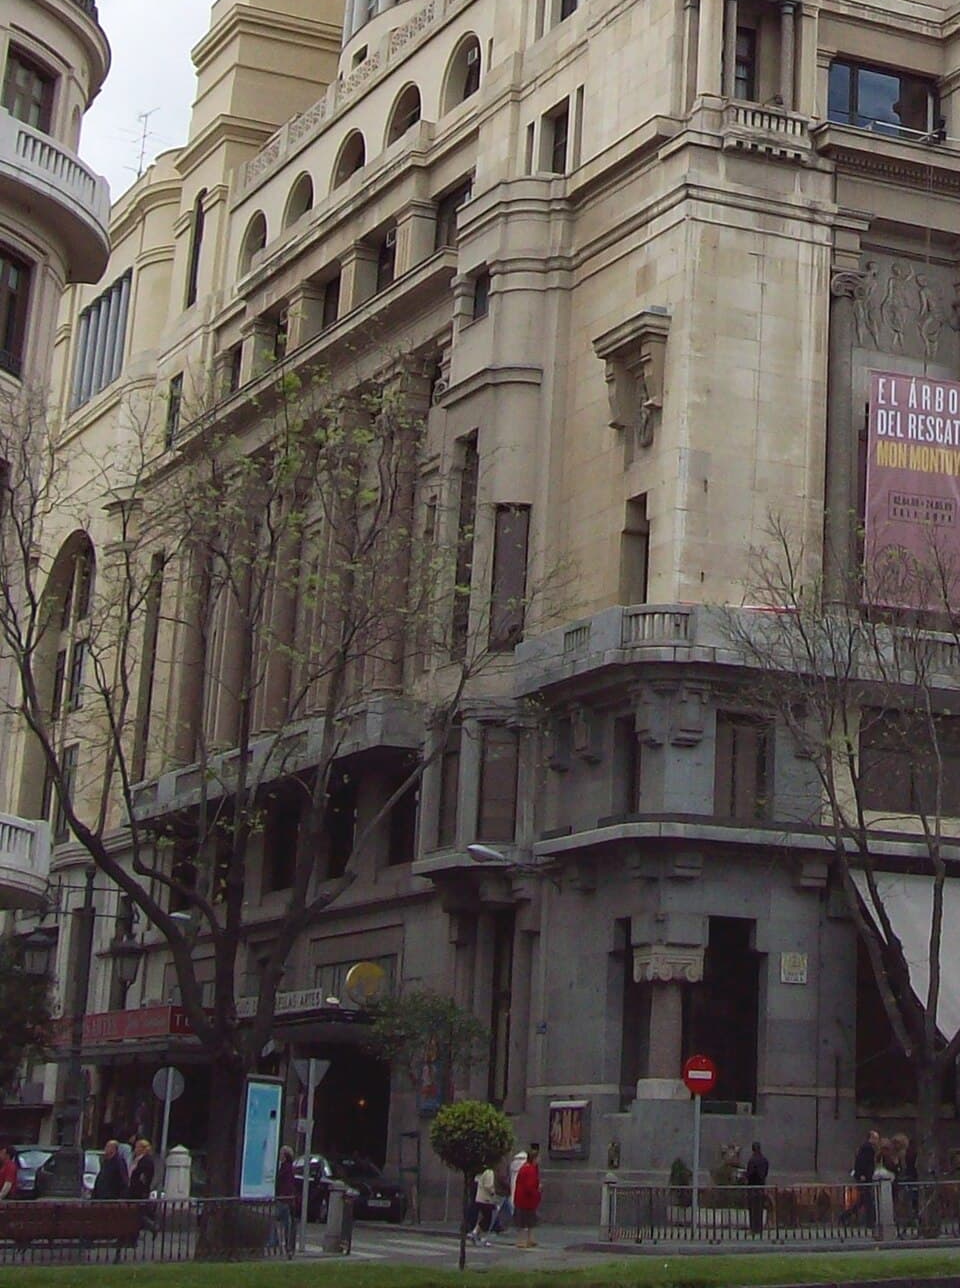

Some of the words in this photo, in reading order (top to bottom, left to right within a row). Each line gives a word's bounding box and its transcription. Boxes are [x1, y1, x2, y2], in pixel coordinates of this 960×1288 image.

[878, 378, 898, 406] EL
[877, 409, 905, 438] DEL
[876, 440, 907, 469] MON
